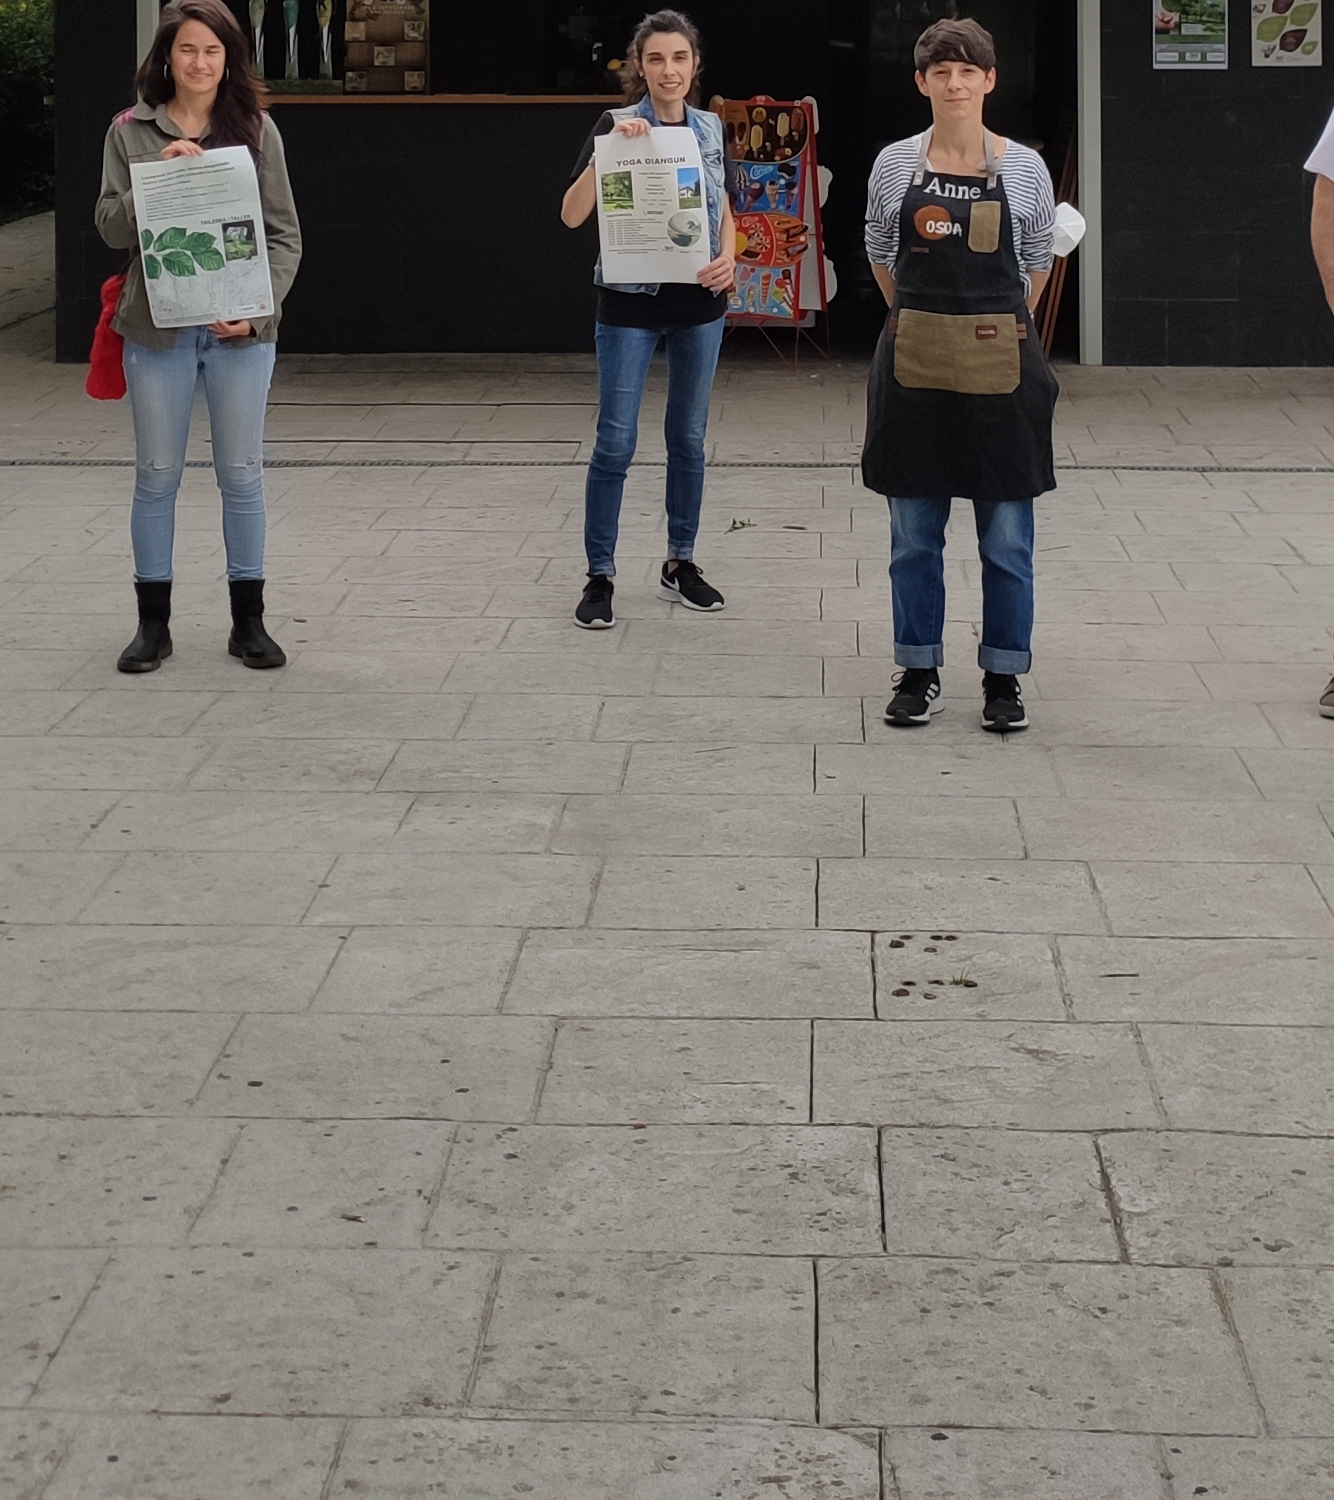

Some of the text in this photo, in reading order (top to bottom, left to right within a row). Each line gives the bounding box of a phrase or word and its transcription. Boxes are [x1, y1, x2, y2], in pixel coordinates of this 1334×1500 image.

[616, 156, 686, 167] YOGA OIANGUN
[923, 177, 982, 200] Anne
[925, 220, 962, 238] OSOA
